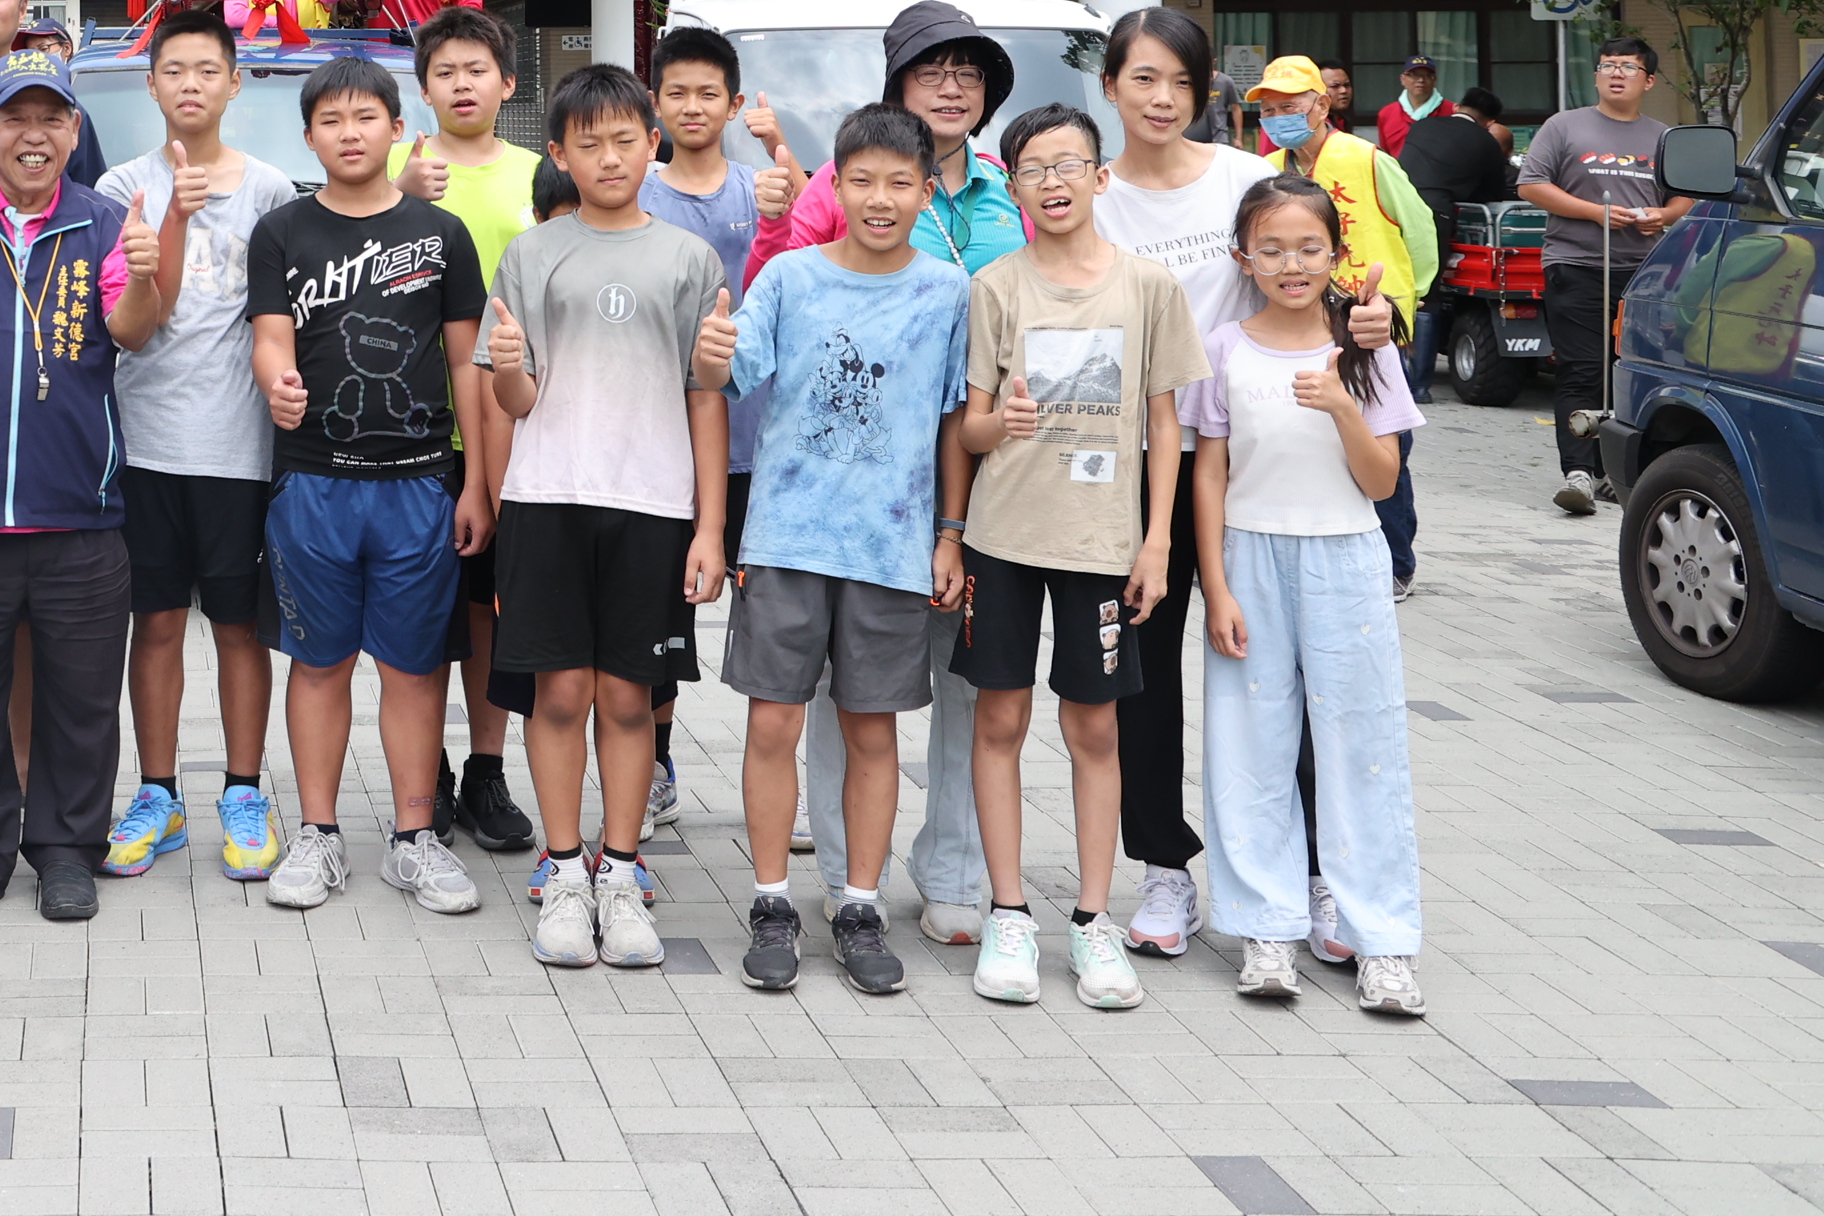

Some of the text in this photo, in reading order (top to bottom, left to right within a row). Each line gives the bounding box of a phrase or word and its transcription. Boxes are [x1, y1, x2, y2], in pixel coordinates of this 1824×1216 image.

[1135, 228, 1232, 257] EVERYTHING
[1178, 251, 1198, 266] BE
[52, 265, 69, 359] 主任委員 魏文芳
[68, 259, 91, 361] 霧峰新德宮
[366, 338, 392, 349] CHINA
[1505, 339, 1541, 352] YKM
[1037, 403, 1121, 416] ILVER PEAKS
